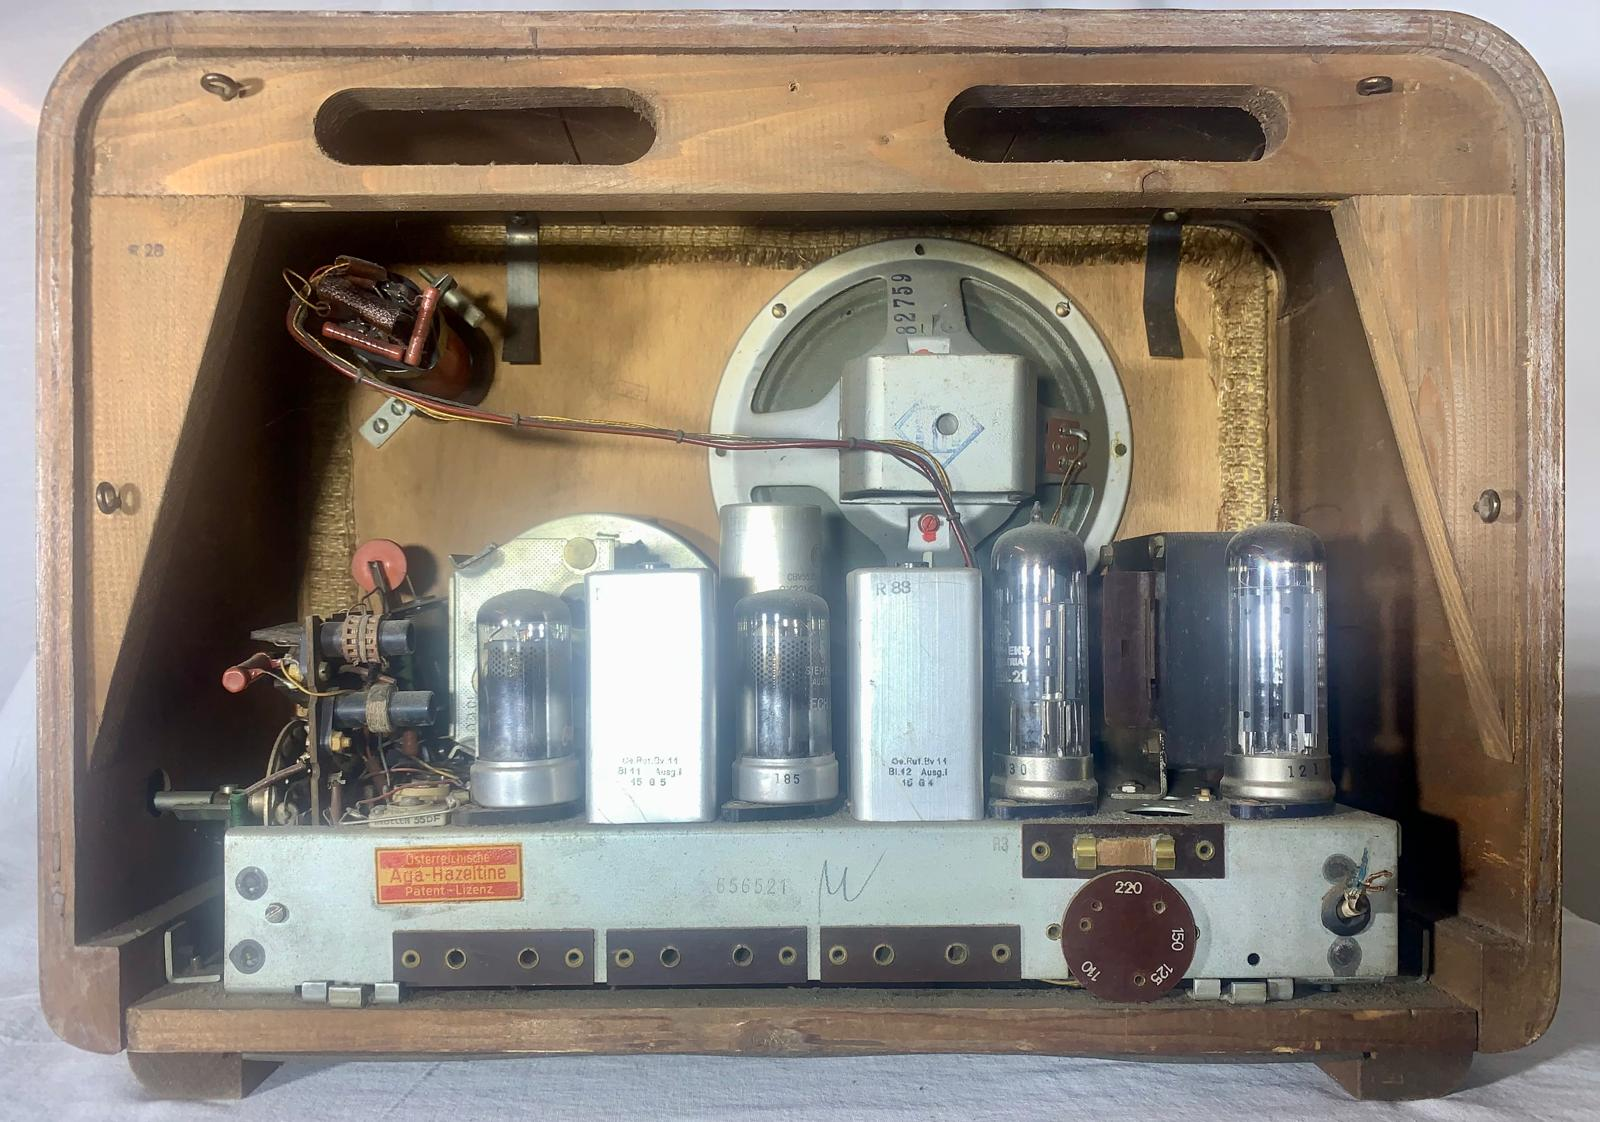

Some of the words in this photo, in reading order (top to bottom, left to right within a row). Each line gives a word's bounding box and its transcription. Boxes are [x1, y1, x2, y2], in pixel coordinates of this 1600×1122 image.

[890, 273, 917, 335] 82759
[775, 773, 800, 784] 185
[389, 865, 507, 886] Aga-Hazeltine
[716, 877, 787, 896] 656521
[1114, 880, 1143, 895] 220
[1171, 927, 1185, 952] 150
[1081, 960, 1101, 982] 110
[1150, 963, 1174, 986] 125
